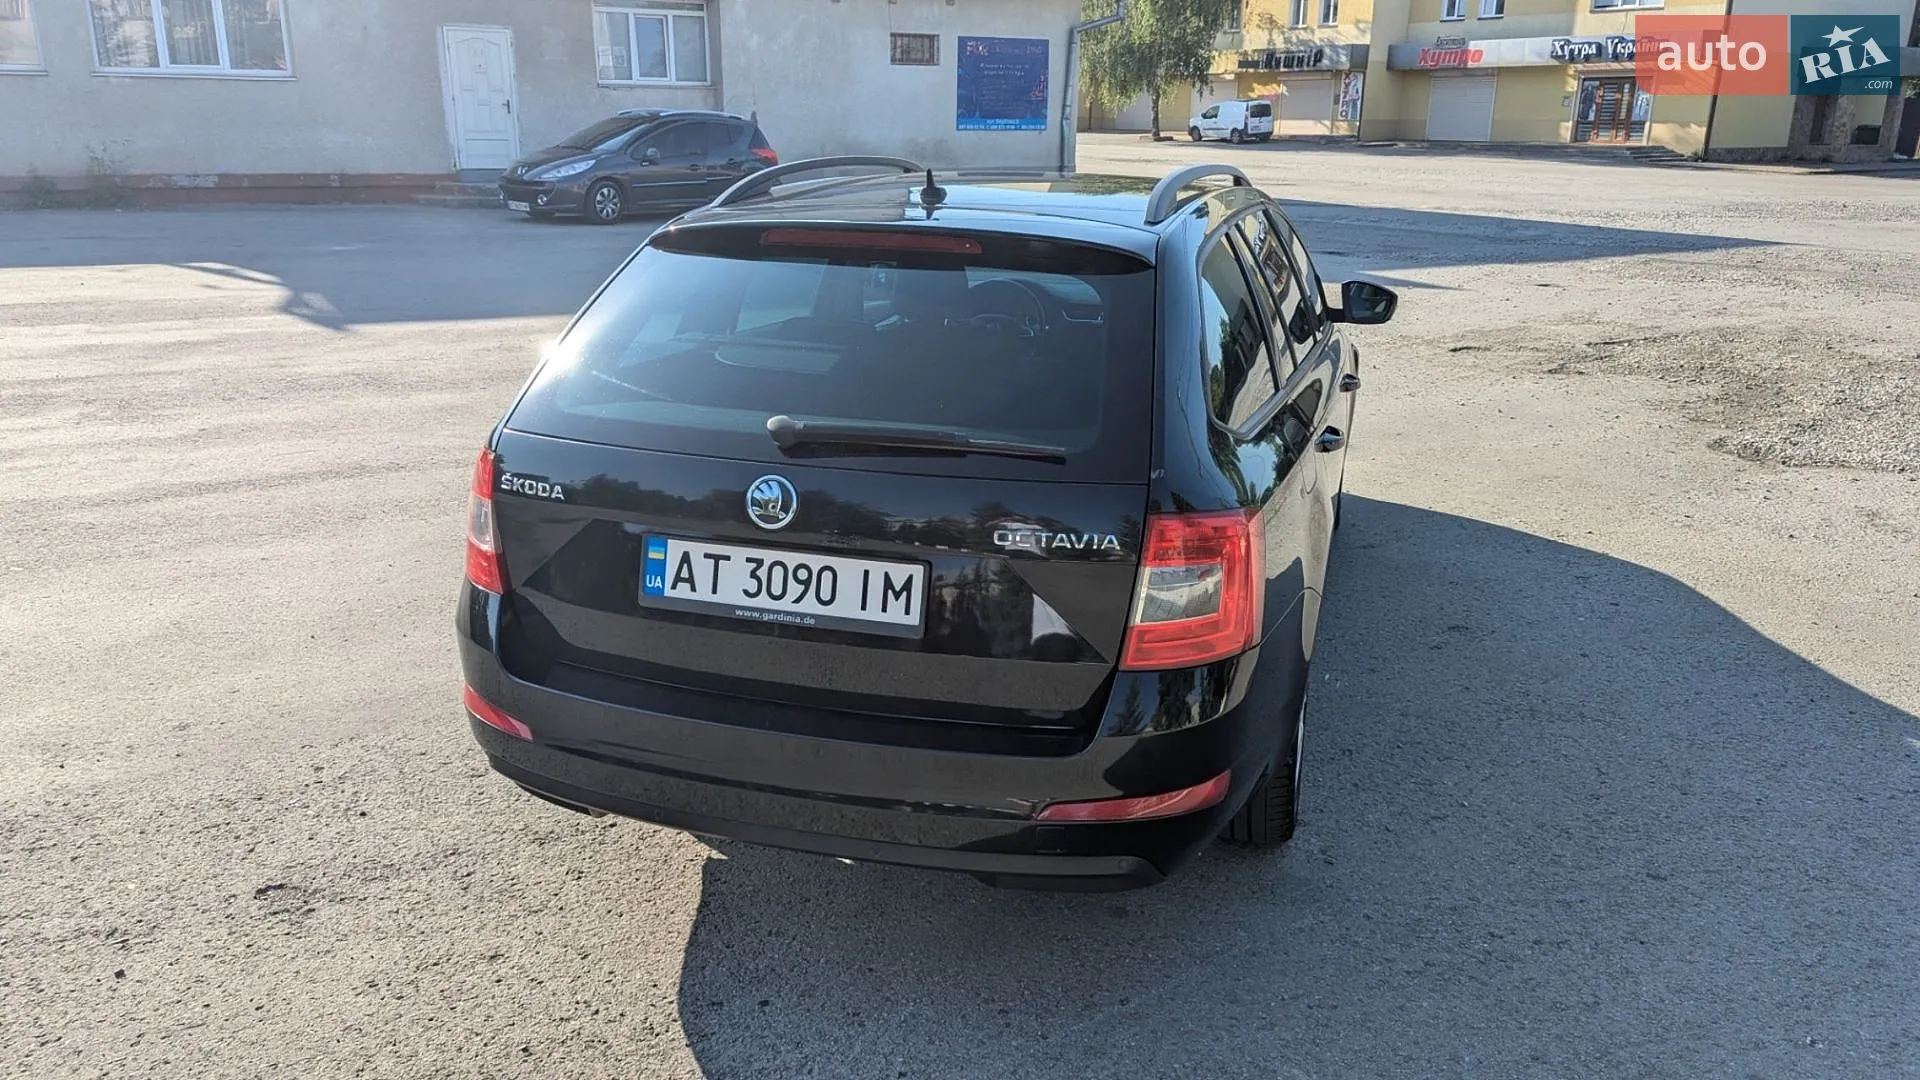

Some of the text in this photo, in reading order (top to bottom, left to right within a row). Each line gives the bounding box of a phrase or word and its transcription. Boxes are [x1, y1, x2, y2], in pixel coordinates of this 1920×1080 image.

[1417, 47, 1485, 68] Хутро
[1552, 40, 1597, 60] Хутра
[500, 472, 566, 501] ŠKODA
[993, 530, 1121, 550] OCTAVIA
[646, 574, 663, 589] UA
[670, 550, 914, 616] AT 3090 IM
[735, 607, 816, 625] www.gardinia.de
